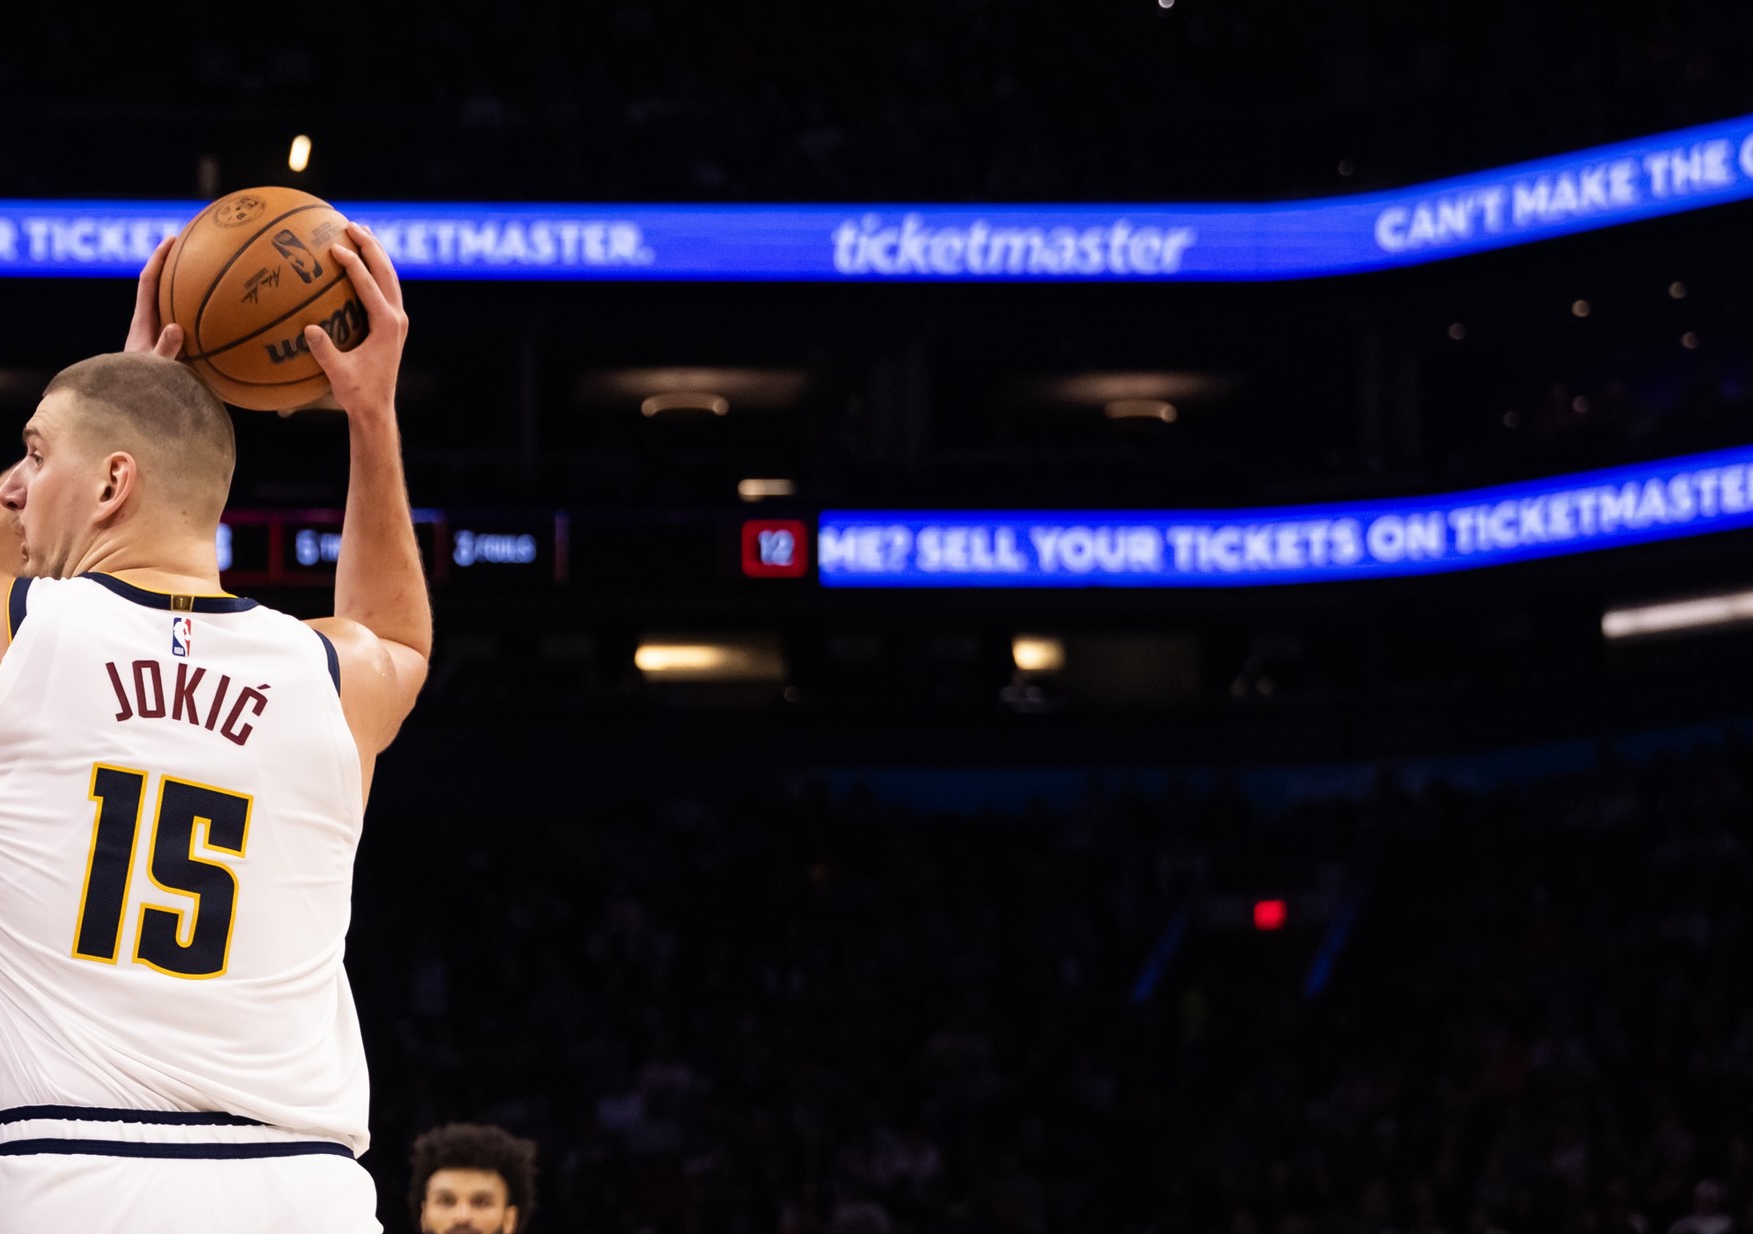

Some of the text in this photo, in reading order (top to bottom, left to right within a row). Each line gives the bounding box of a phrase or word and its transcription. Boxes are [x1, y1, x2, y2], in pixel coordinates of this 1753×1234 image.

[833, 215, 1194, 273] ticketmaster
[1375, 187, 1505, 252] CAN'T
[1512, 160, 1635, 227] MAKE
[1646, 140, 1730, 198] THE
[916, 527, 1026, 573] SELL
[1032, 527, 1163, 573] YOUR
[1168, 519, 1362, 573] TICKETS
[1366, 514, 1444, 562] ON
[1449, 464, 1753, 552] TICKETMASTE
[105, 660, 271, 746] JOKIĆ
[71, 761, 254, 980] 15
